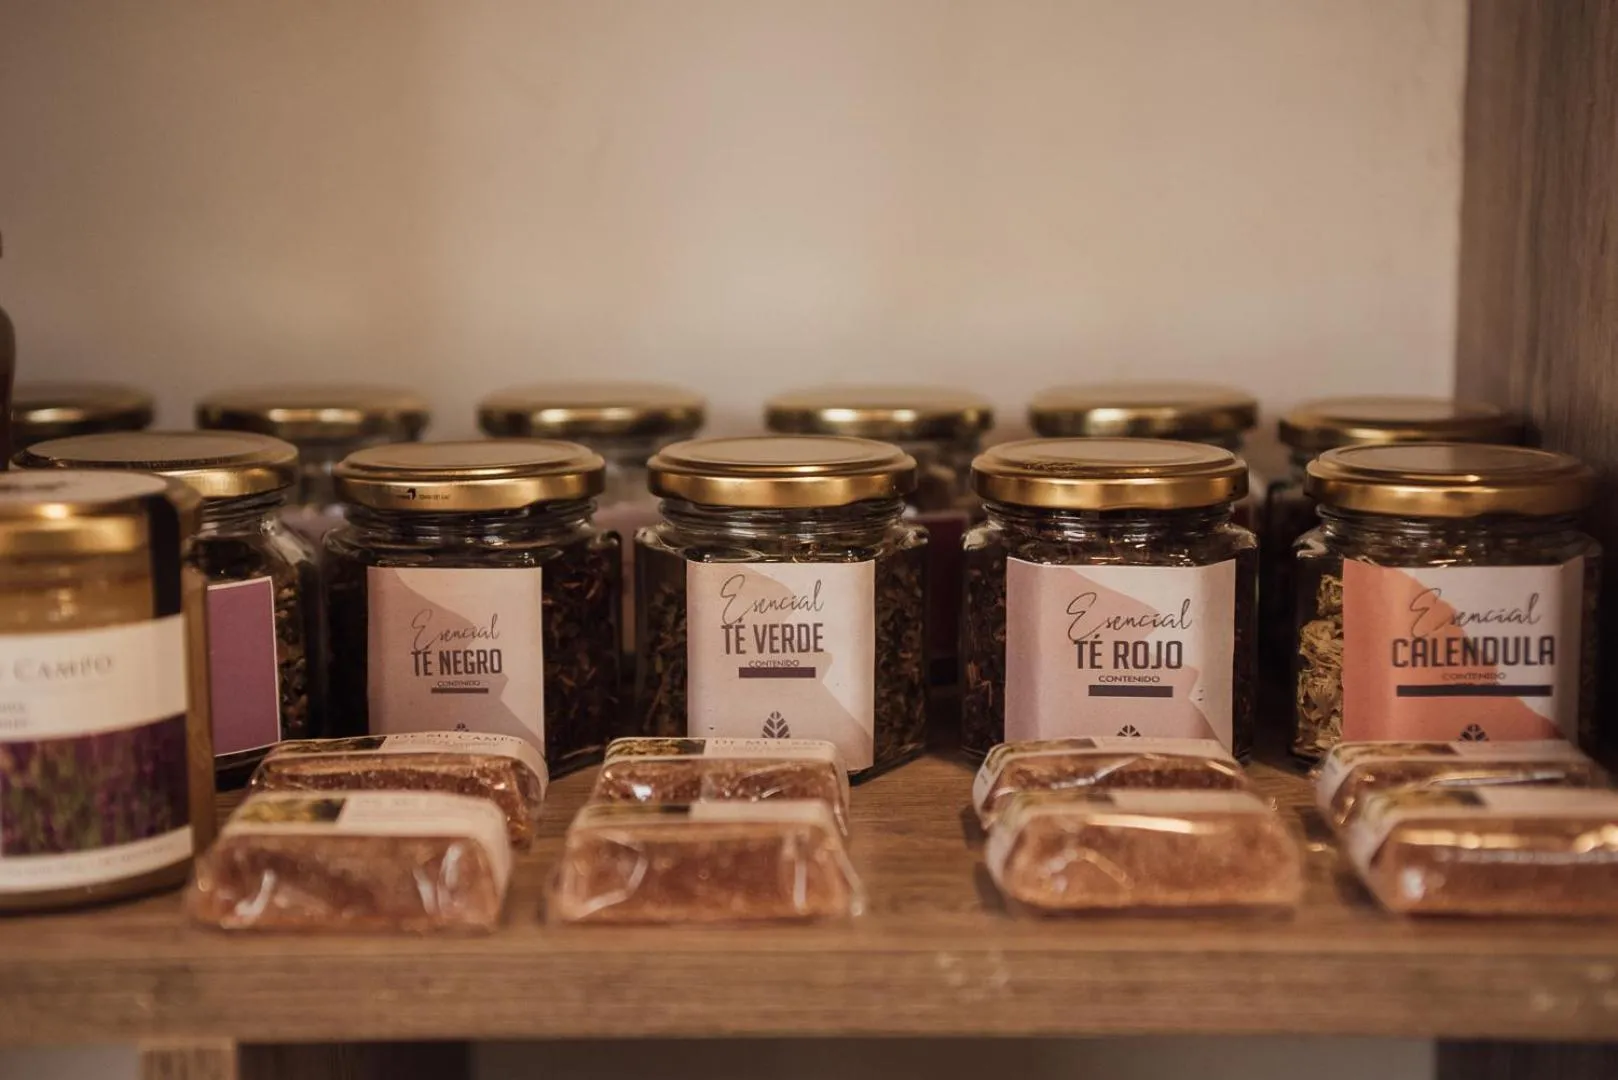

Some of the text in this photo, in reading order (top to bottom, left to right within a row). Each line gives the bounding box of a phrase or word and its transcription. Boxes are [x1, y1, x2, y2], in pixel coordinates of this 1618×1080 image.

[720, 574, 824, 624] Esencial
[1410, 587, 1541, 638] Esencial
[411, 609, 500, 650] Esencial
[1066, 592, 1193, 641] Esencial
[753, 623, 824, 655] VERDE
[1074, 634, 1183, 669] TÉ ROJO
[1392, 635, 1556, 668] CALENDULA
[439, 648, 503, 675] NEGRO
[748, 659, 800, 668] CONTENIDO
[1441, 672, 1507, 681] CONTENIDO
[437, 680, 481, 688] CONTENIDO
[1098, 674, 1160, 683] CONTENIDO
